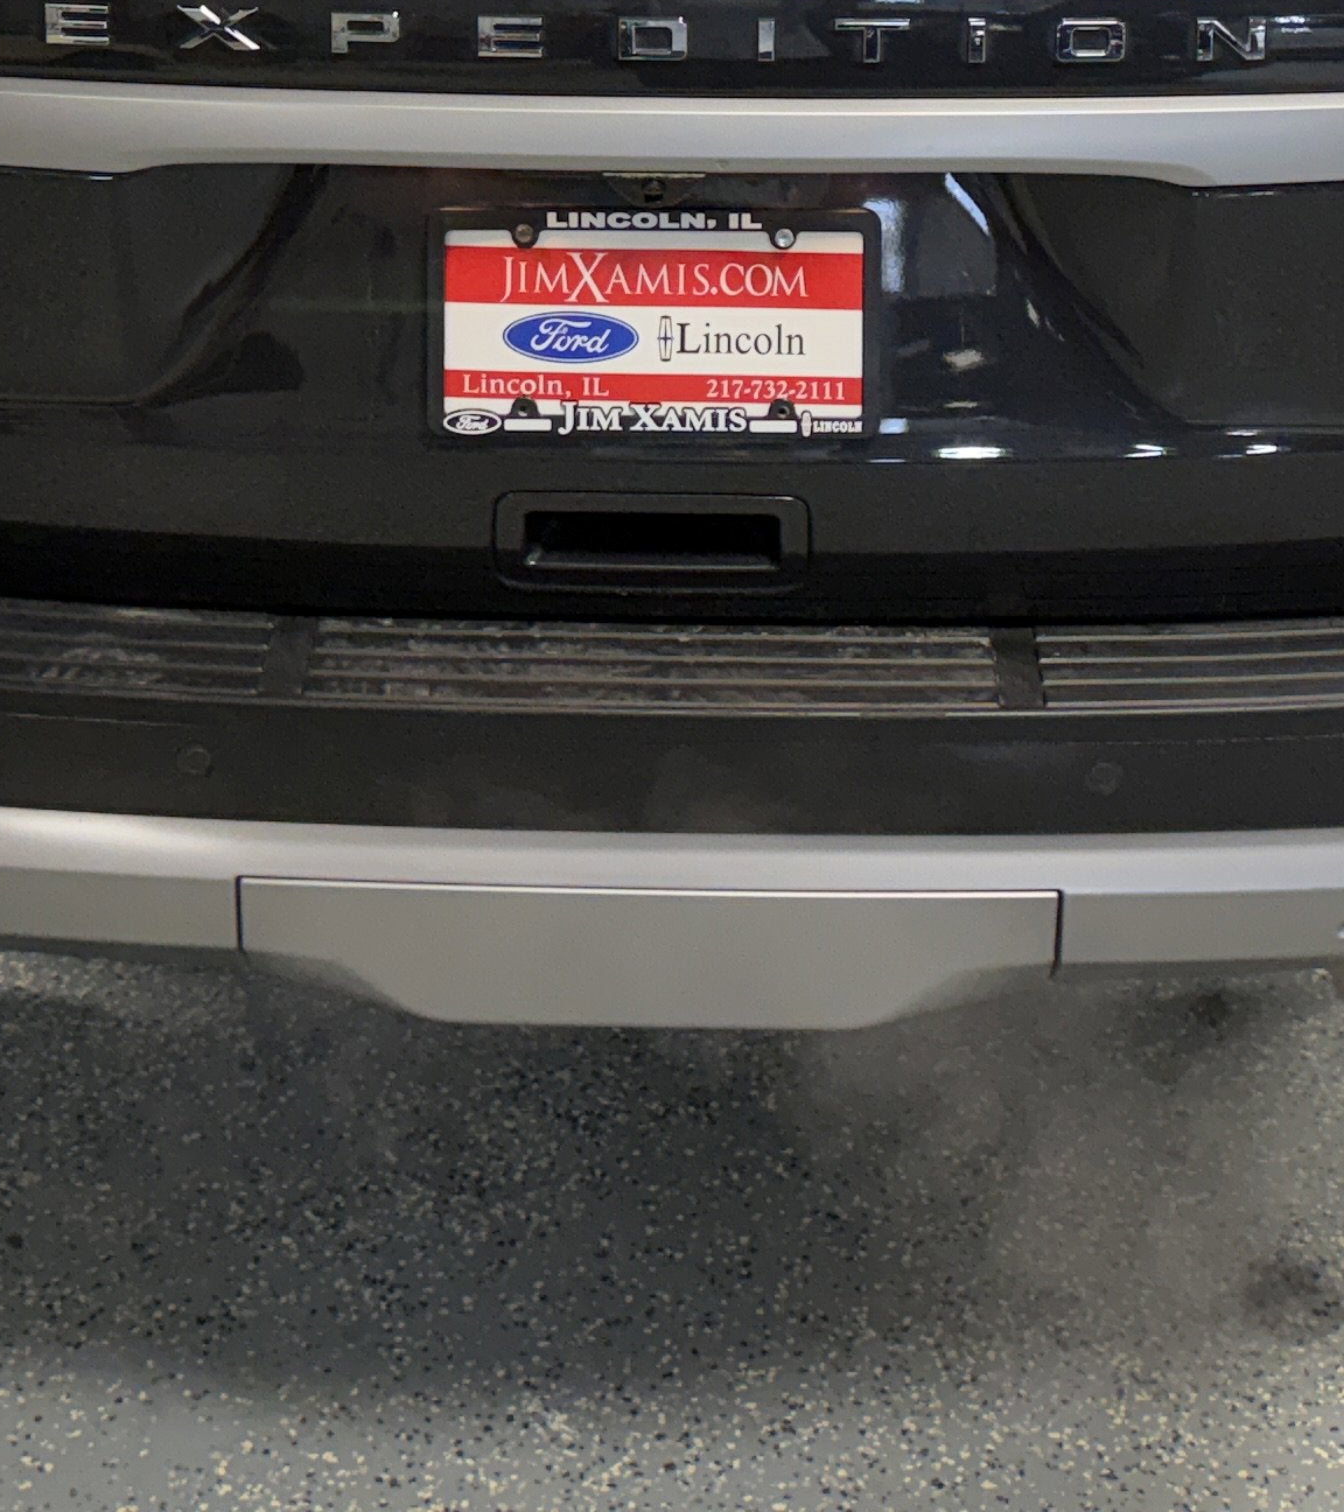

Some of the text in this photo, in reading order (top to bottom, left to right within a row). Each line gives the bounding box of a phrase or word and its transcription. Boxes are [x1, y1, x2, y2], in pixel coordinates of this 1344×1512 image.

[44, 2, 1266, 65] EXPEDITION
[545, 211, 763, 231] LINCOLN, IL
[499, 251, 809, 304] JIMXAMIS.COM
[529, 318, 613, 354] Ford
[676, 321, 806, 357] Lincoln
[461, 374, 610, 399] Lincoln, IL
[705, 379, 846, 401] 217-732-2111
[557, 400, 748, 436] JIM XAMIS
[813, 420, 863, 433] LINCOLN
